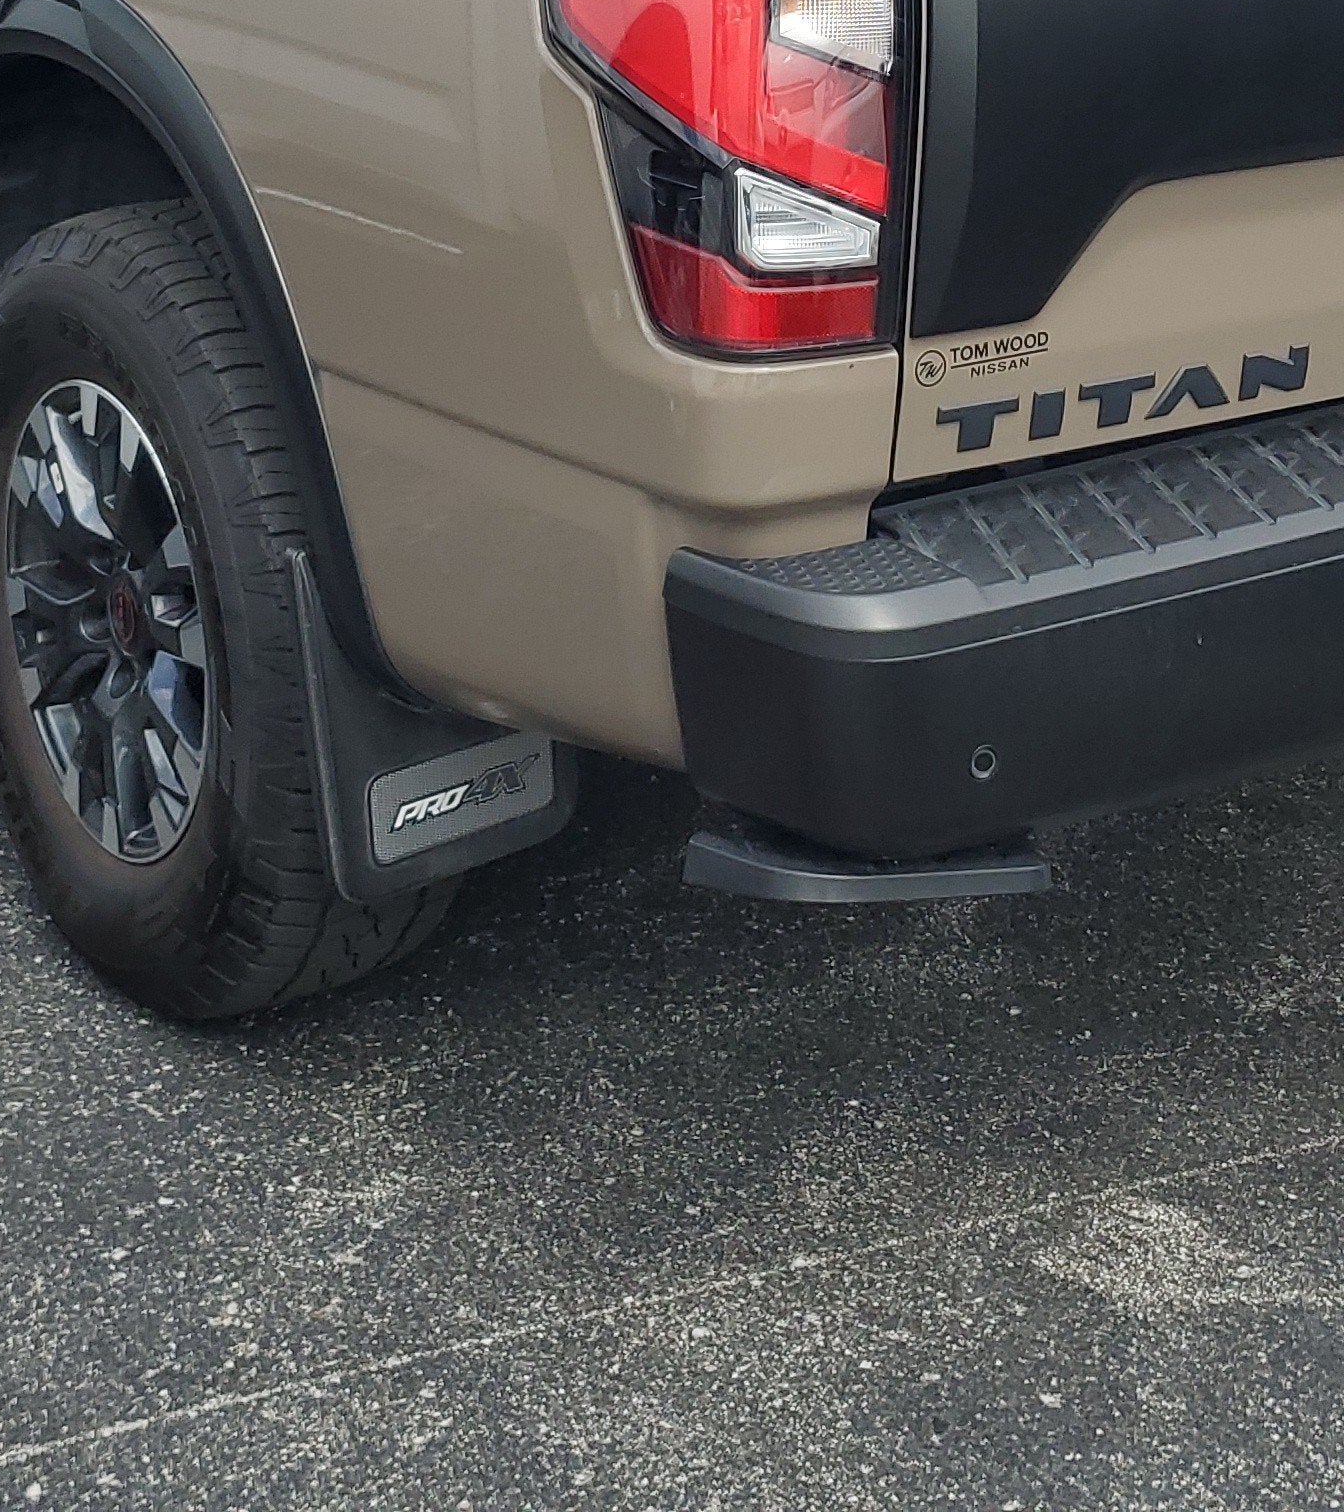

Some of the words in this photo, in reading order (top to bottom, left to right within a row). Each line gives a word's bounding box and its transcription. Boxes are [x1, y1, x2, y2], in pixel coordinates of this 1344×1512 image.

[950, 341, 989, 363] TOM
[993, 331, 1049, 354] WOOD
[970, 356, 1030, 378] NISSAN
[936, 343, 1310, 453] TITAN
